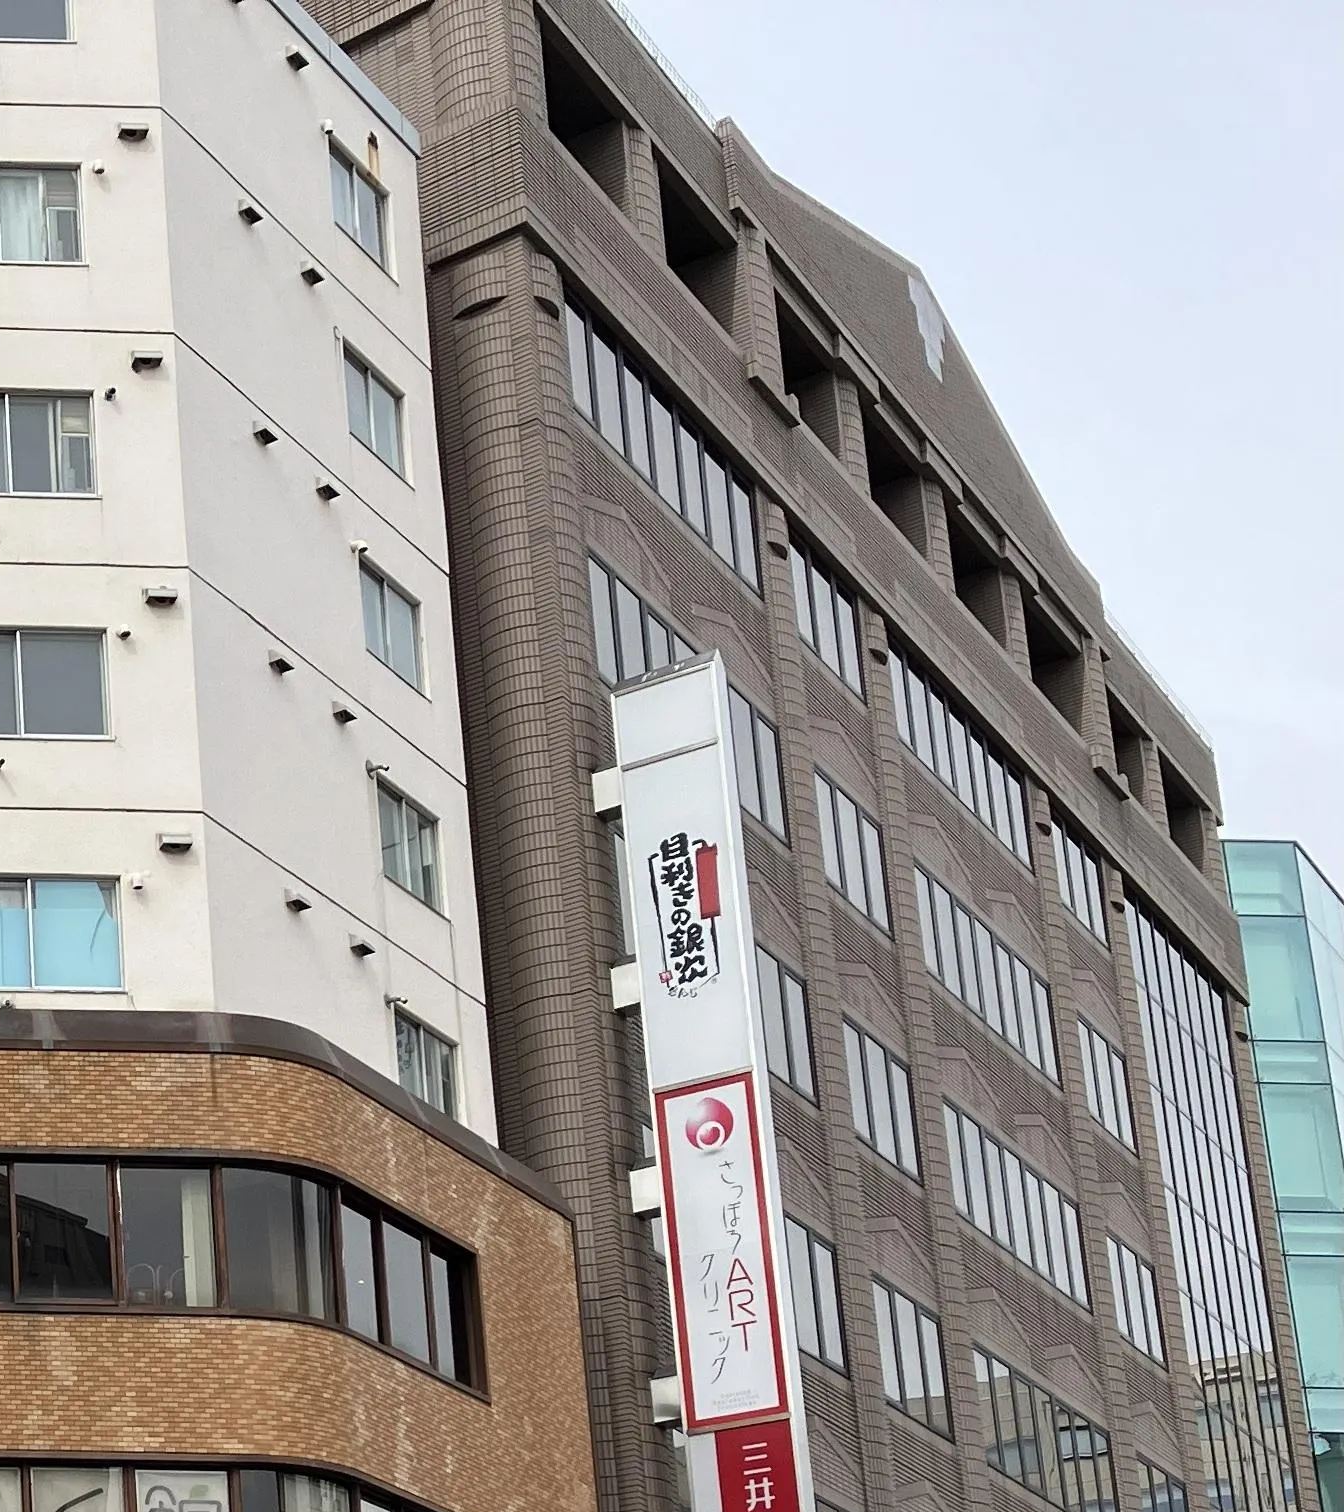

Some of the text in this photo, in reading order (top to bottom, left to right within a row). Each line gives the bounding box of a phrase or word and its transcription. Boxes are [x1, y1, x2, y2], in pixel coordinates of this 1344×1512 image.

[659, 832, 708, 985] 目利きの銀次
[700, 1253, 731, 1385] クリニック
[726, 1258, 757, 1352] ART
